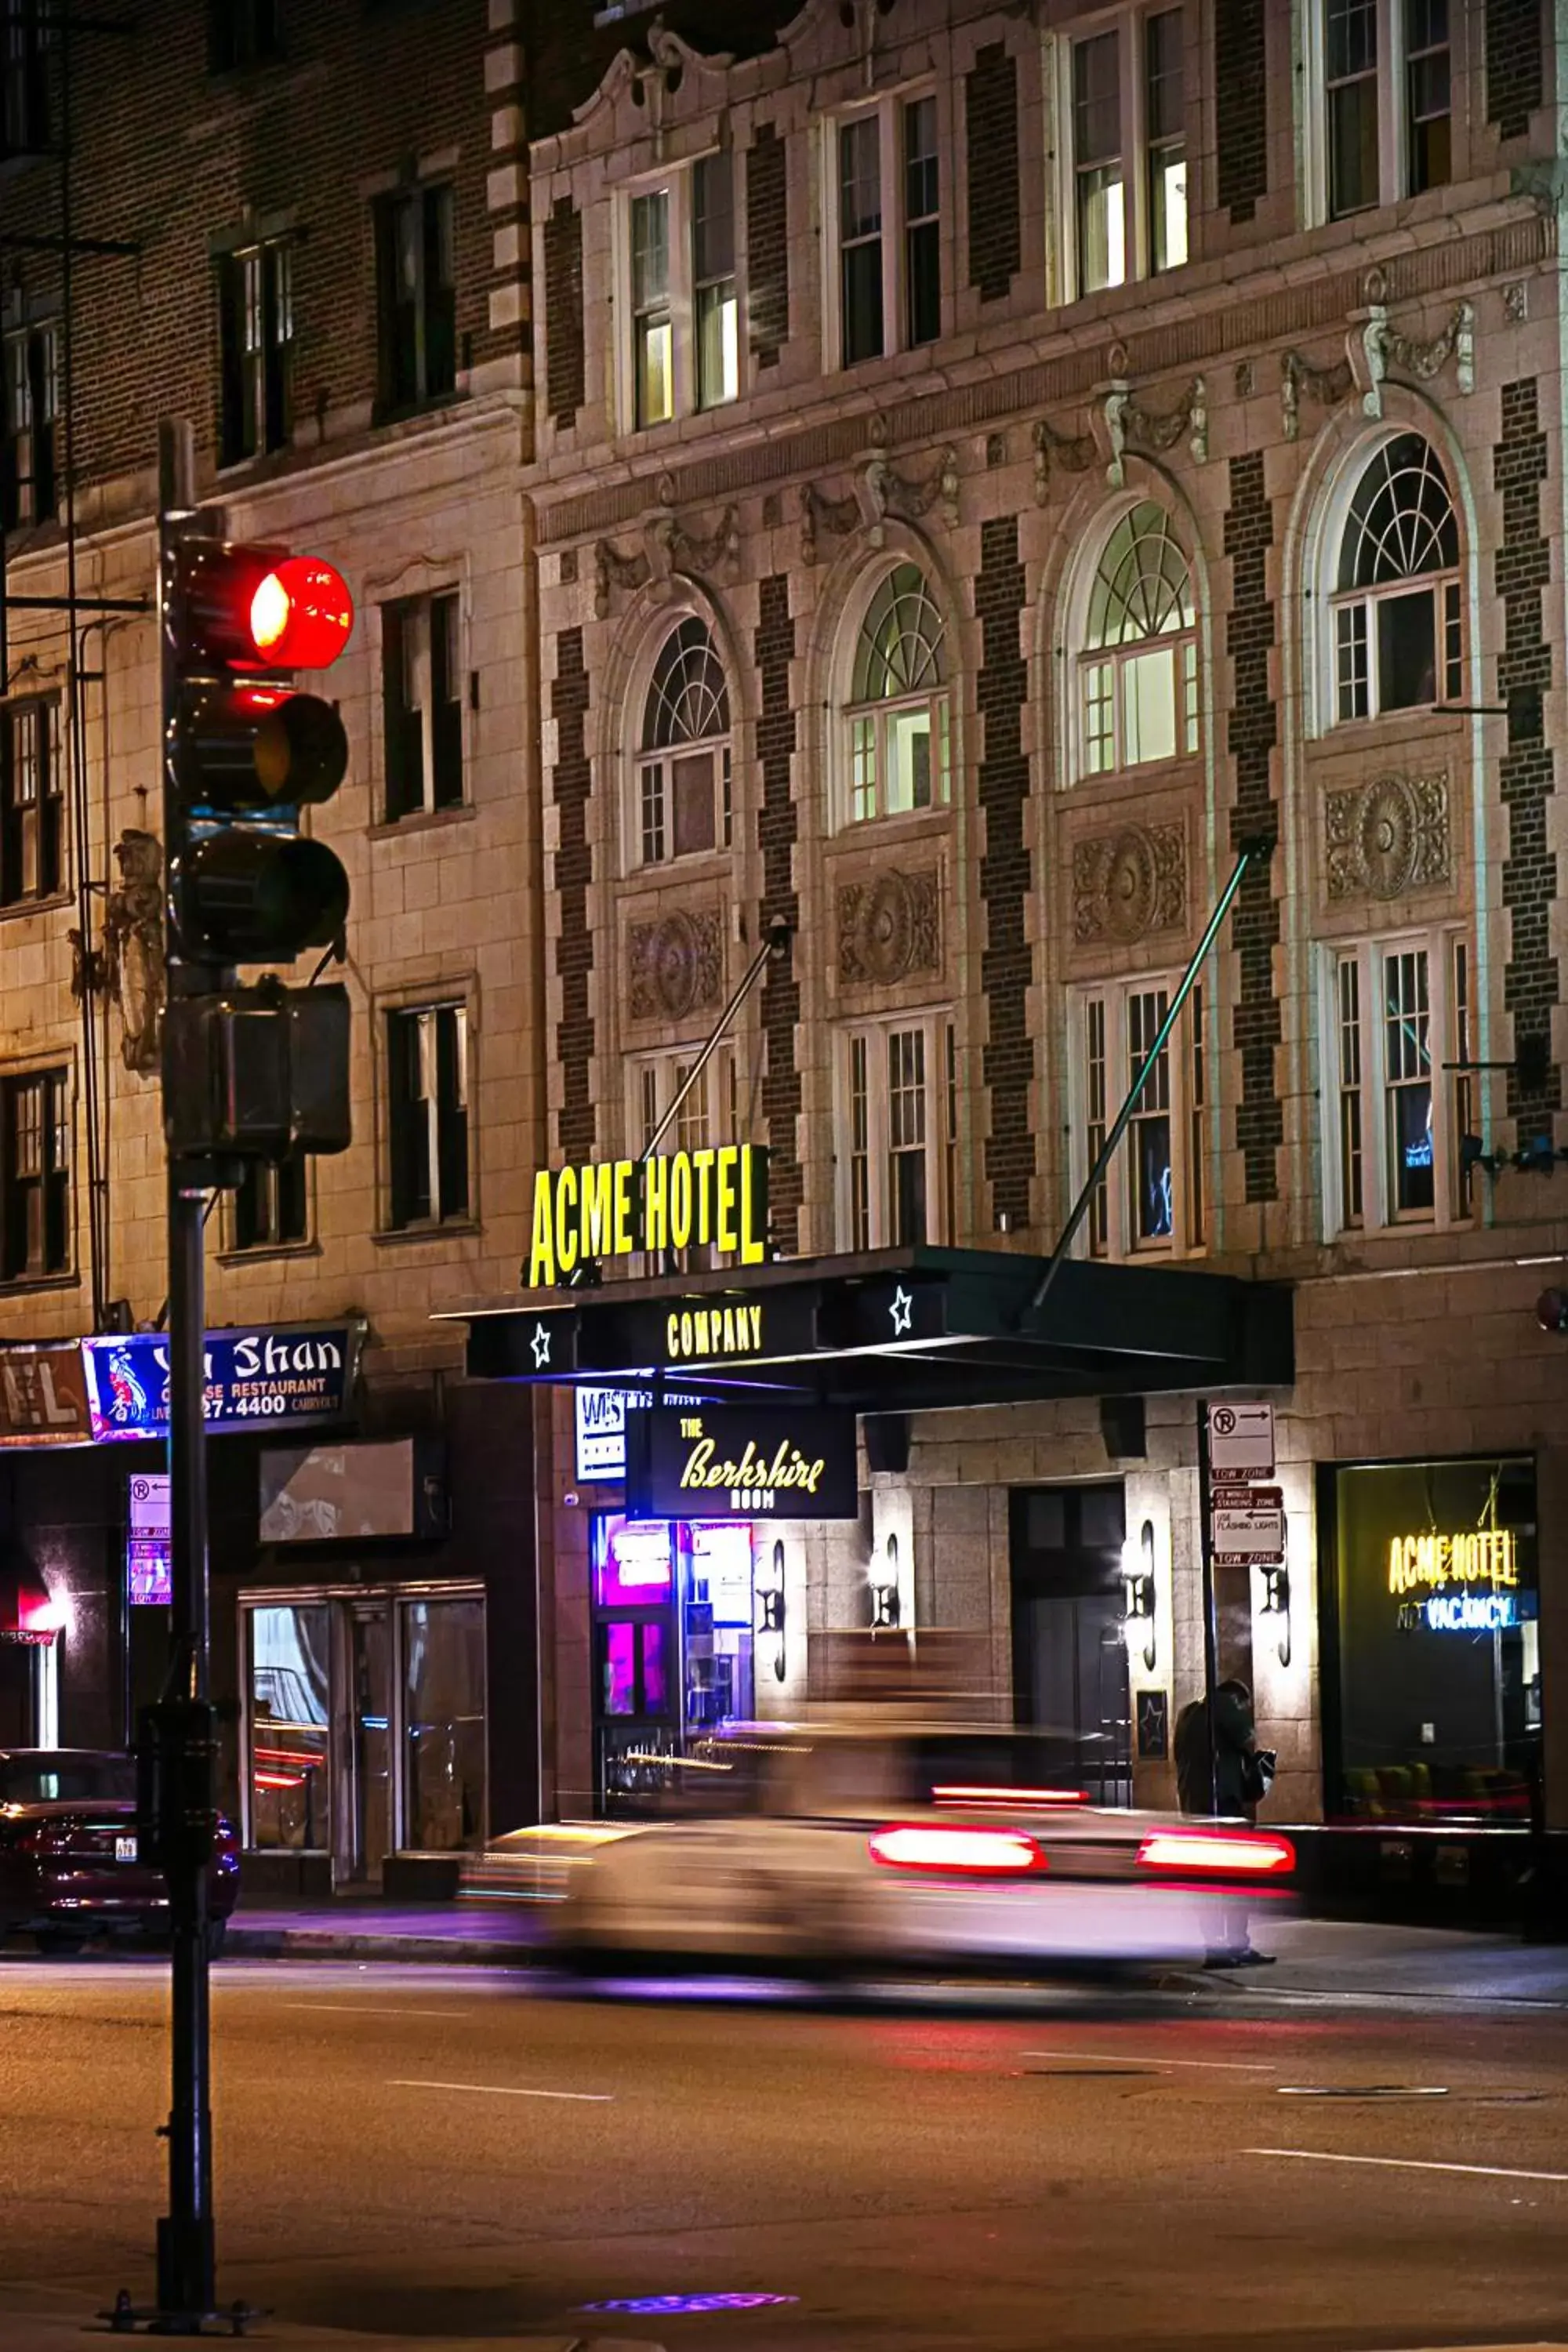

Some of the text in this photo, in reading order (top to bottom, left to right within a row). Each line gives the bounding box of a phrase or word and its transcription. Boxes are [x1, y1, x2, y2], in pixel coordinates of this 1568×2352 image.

[530, 1143, 764, 1287] ACME HOTEL
[666, 1305, 762, 1358] COMPANY
[234, 1335, 342, 1377] Shan
[232, 1377, 326, 1399] RESTAURANT
[200, 1394, 285, 1419] 27-4400
[680, 1417, 703, 1439] THE
[680, 1438, 826, 1494] Berkshire
[1215, 1468, 1269, 1479] TOW ZONE
[730, 1490, 775, 1509] ROOM
[1218, 1552, 1279, 1564] TOW ZONE
[1389, 1530, 1517, 1594] ACME HOTEL
[1427, 1595, 1511, 1630] VACANCY
